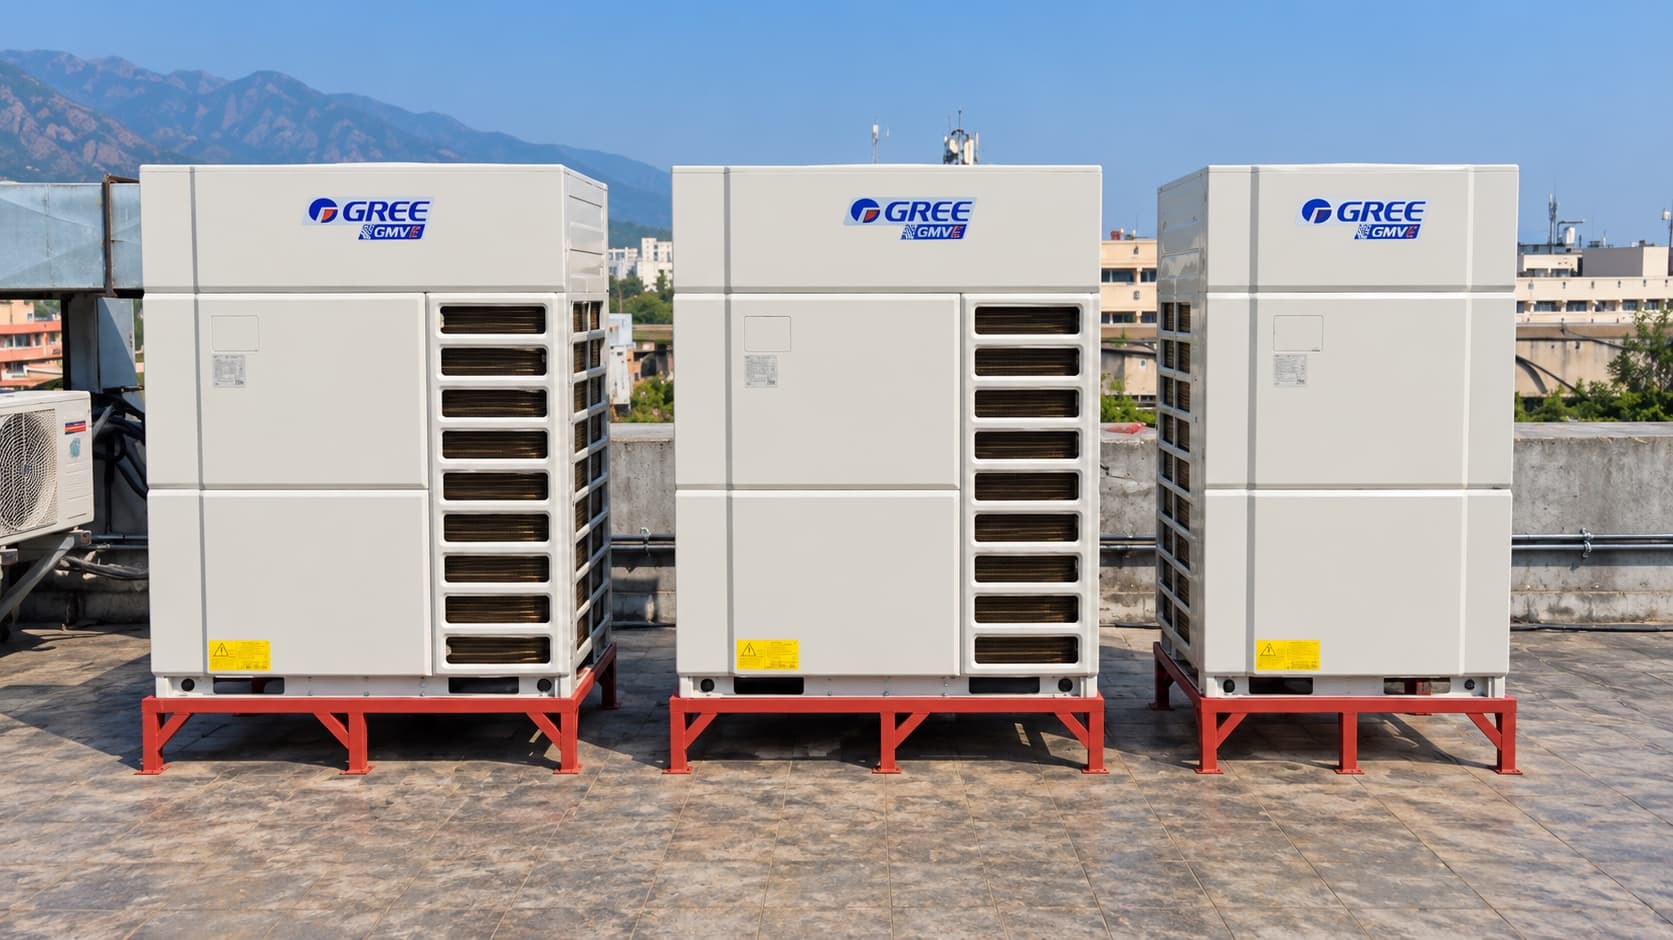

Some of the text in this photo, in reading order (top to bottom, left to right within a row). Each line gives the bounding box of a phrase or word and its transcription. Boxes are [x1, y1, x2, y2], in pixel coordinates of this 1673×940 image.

[343, 201, 430, 222] GREE
[885, 201, 973, 222] GREE
[1337, 201, 1426, 222] GREE
